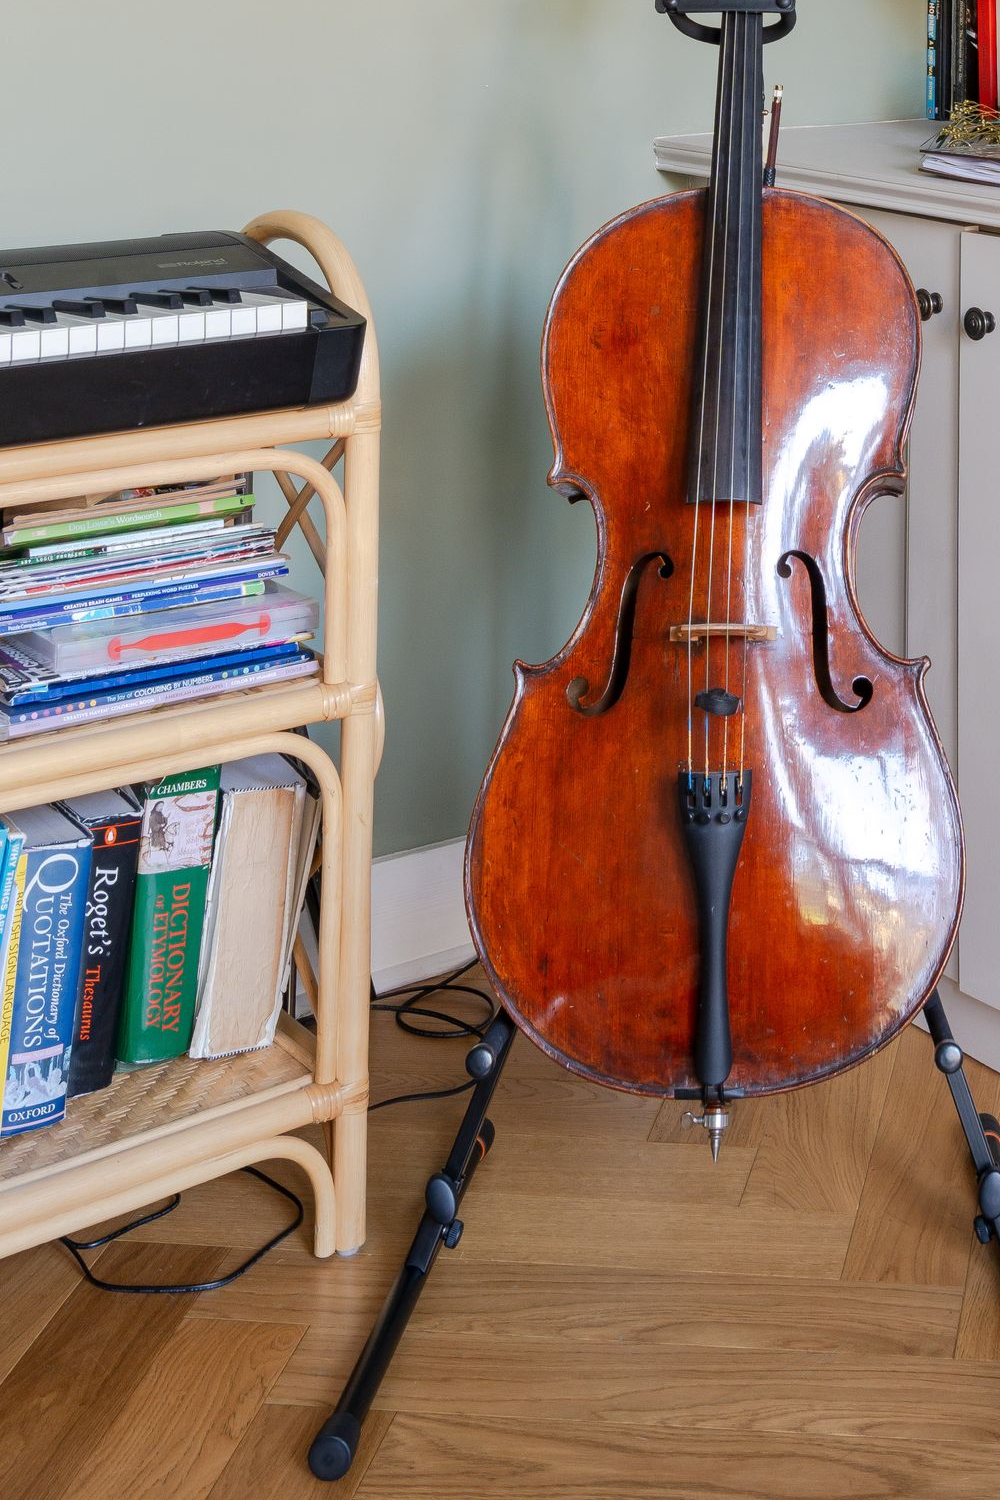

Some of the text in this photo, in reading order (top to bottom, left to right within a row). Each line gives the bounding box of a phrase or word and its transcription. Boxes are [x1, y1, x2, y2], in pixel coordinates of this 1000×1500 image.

[257, 571, 275, 579] DOVER
[63, 583, 199, 611] CREATIVE BRAIN GAMES PERPLEXING WORD PUZZLES
[117, 694, 126, 703] Joy
[126, 692, 133, 700] of
[134, 685, 173, 698] COLOURING
[173, 682, 182, 690] BY
[182, 674, 214, 689] NUMBERS
[230, 678, 248, 686] COLOR
[63, 712, 89, 722] CREATIVE
[111, 702, 139, 712] COLORING
[139, 698, 155, 707] BOOK
[157, 779, 207, 795] CHAMBERS
[0, 843, 20, 910] WHY THINGS
[156, 894, 165, 909] OF
[23, 853, 79, 1047] QUOTATIONS
[79, 866, 119, 1041] Roget's Thesaurus
[162, 882, 191, 1032] DICTIONARY
[0, 891, 24, 1044] BRITISH SIGN LANGUAGE
[44, 892, 73, 1041] The Oxford Dictionary of
[145, 912, 168, 1028] ETYMOLOGY
[8, 1103, 56, 1123] OXFORD
